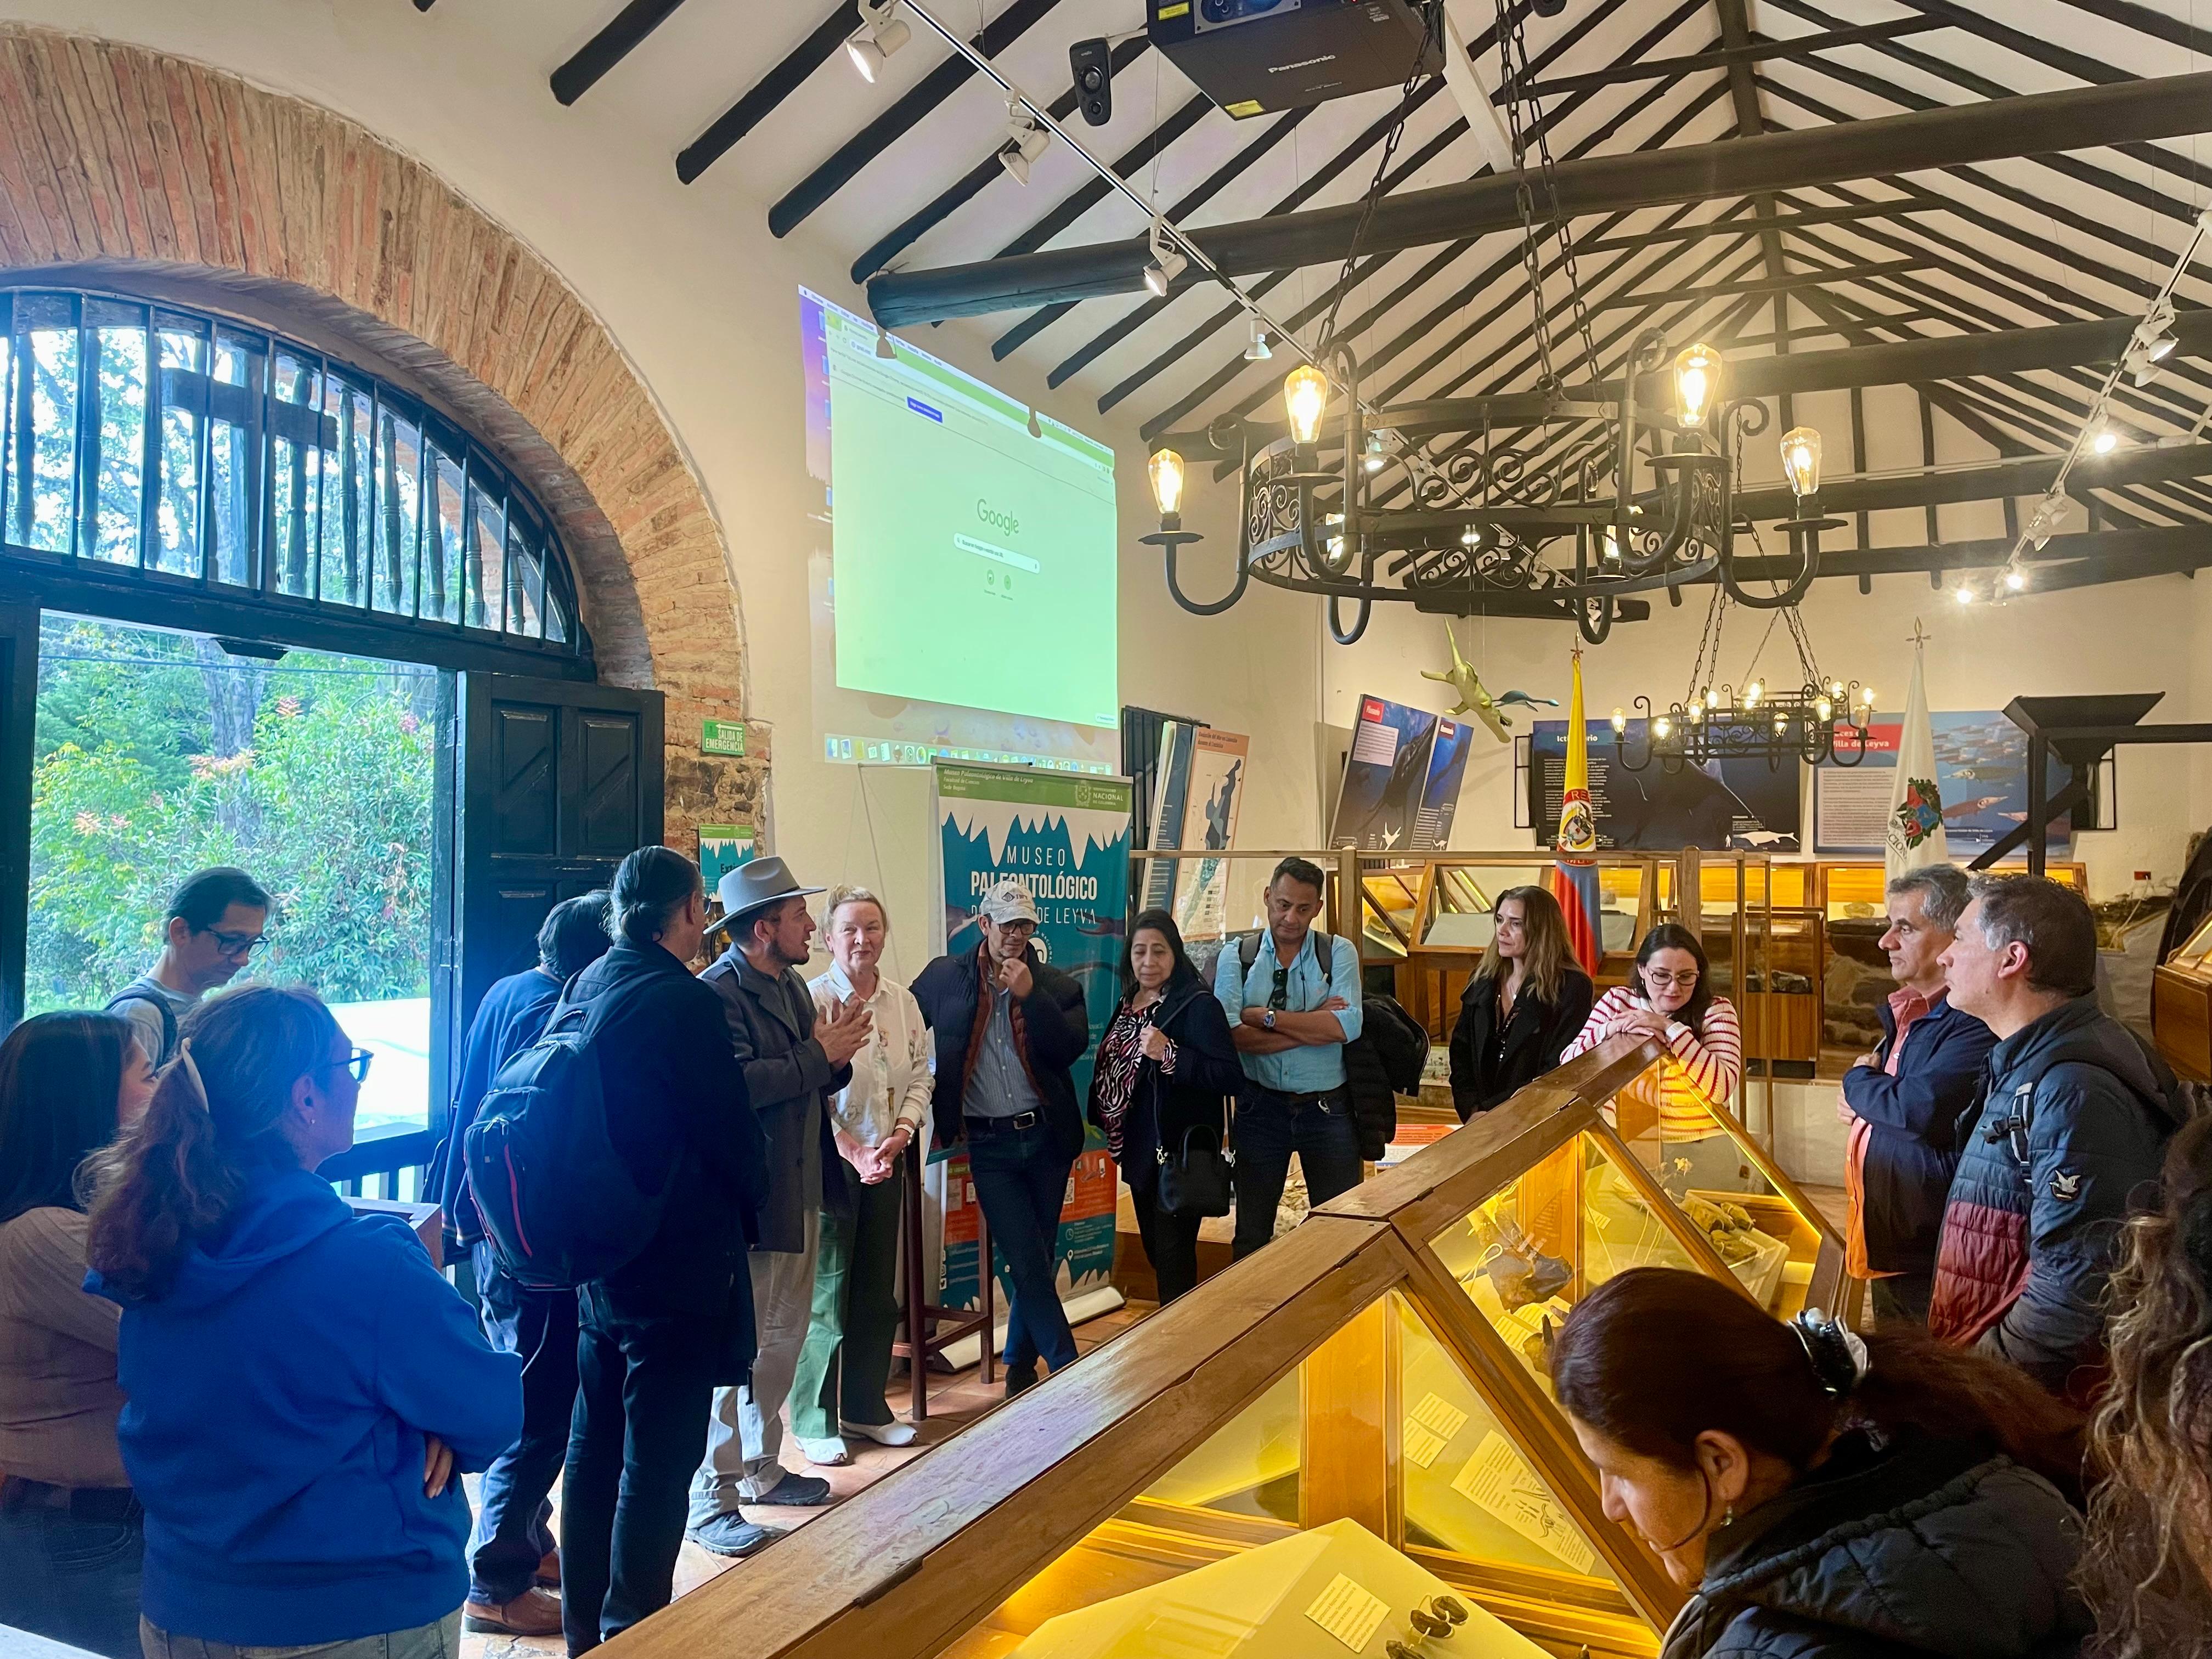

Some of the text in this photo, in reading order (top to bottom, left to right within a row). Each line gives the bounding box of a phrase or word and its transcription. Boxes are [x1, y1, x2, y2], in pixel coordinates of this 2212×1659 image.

[1268, 54, 1336, 74] Panasonic
[977, 499, 1019, 537] Google
[718, 729, 743, 742] SALIDA DE
[706, 738, 744, 752] EMERGENCIA
[1093, 793, 1123, 801] NACIONAL
[1007, 845, 1065, 866] MUSEO
[1037, 907, 1049, 923] DE
[1056, 907, 1096, 924] LEYVA
